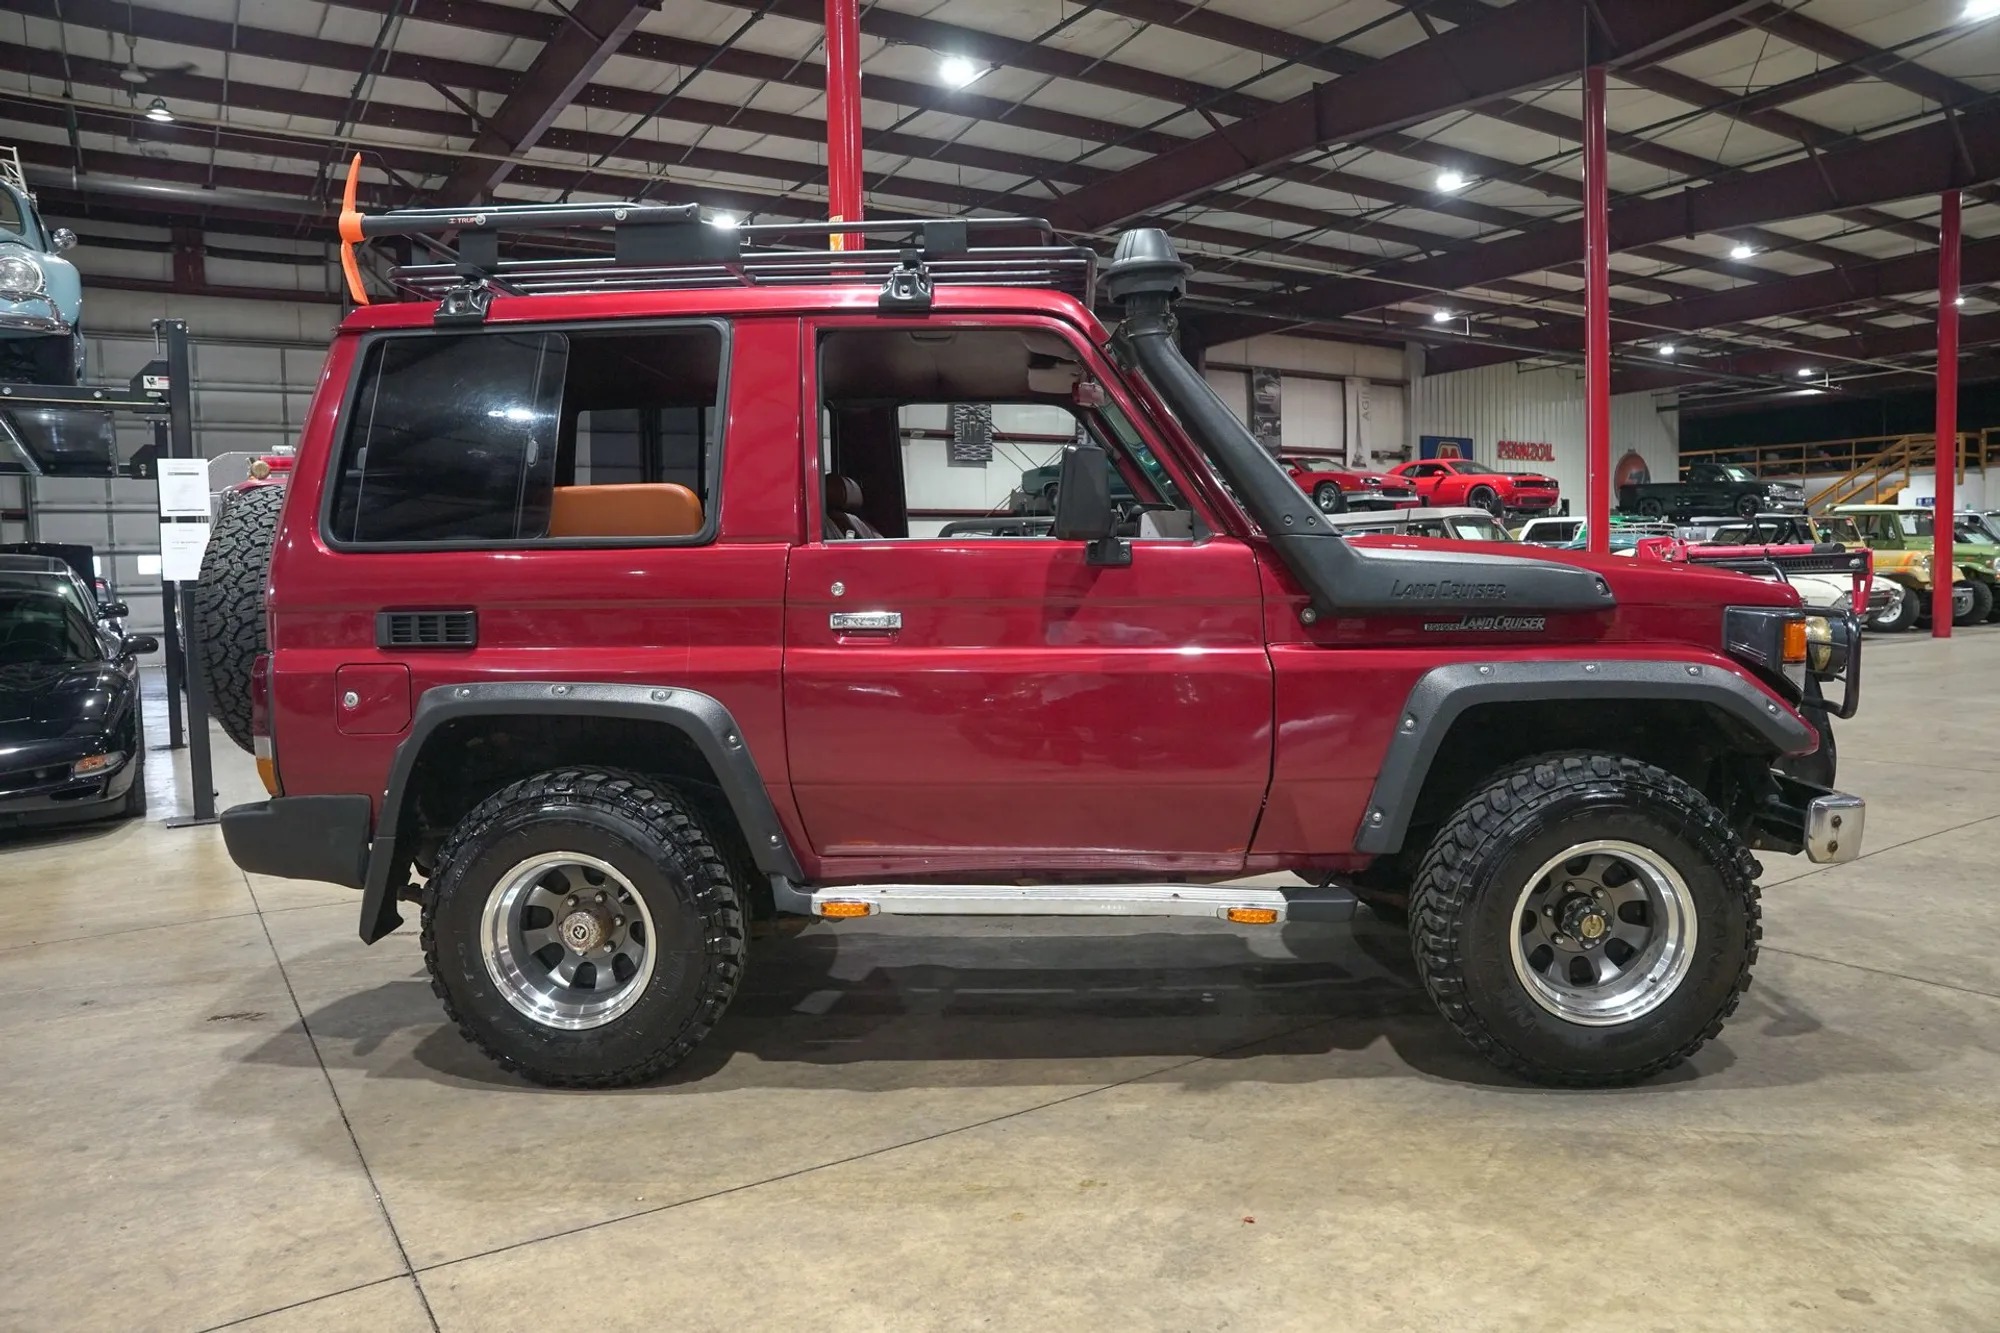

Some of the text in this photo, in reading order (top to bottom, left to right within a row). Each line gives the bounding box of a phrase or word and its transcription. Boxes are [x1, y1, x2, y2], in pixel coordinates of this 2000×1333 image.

[1497, 440, 1555, 461] PENNZOIL
[1391, 579, 1507, 600] LAND CRUISER
[1460, 615, 1494, 630] LAND
[1494, 615, 1546, 630] CRUISER
